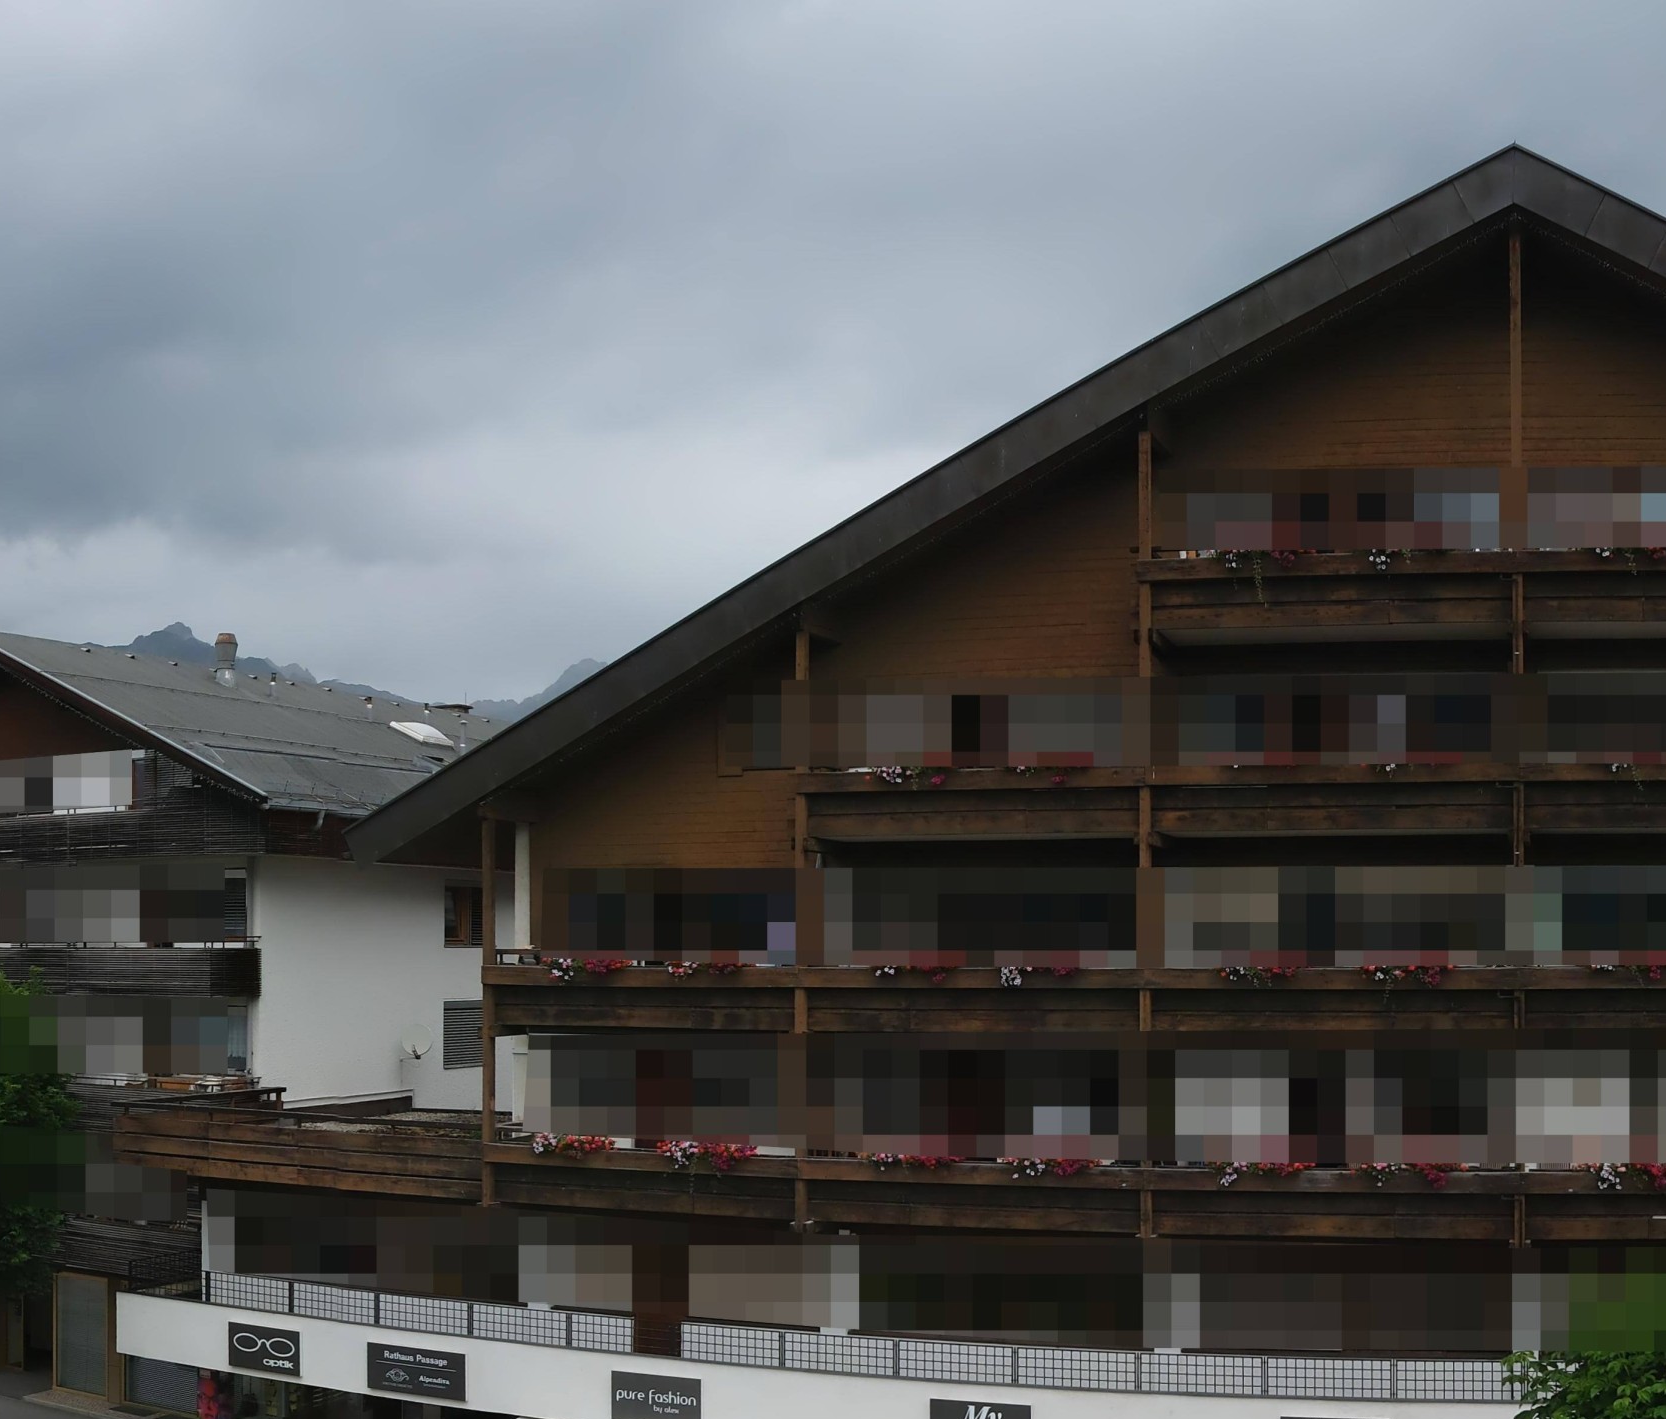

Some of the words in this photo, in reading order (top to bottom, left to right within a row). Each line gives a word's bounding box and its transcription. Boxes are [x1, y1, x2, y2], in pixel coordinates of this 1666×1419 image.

[263, 1358, 294, 1370] optik
[384, 1350, 414, 1362] Rathaus
[416, 1355, 448, 1368] Passage
[616, 1389, 645, 1402] pure
[648, 1389, 696, 1406] fashion
[653, 1405, 663, 1414] by
